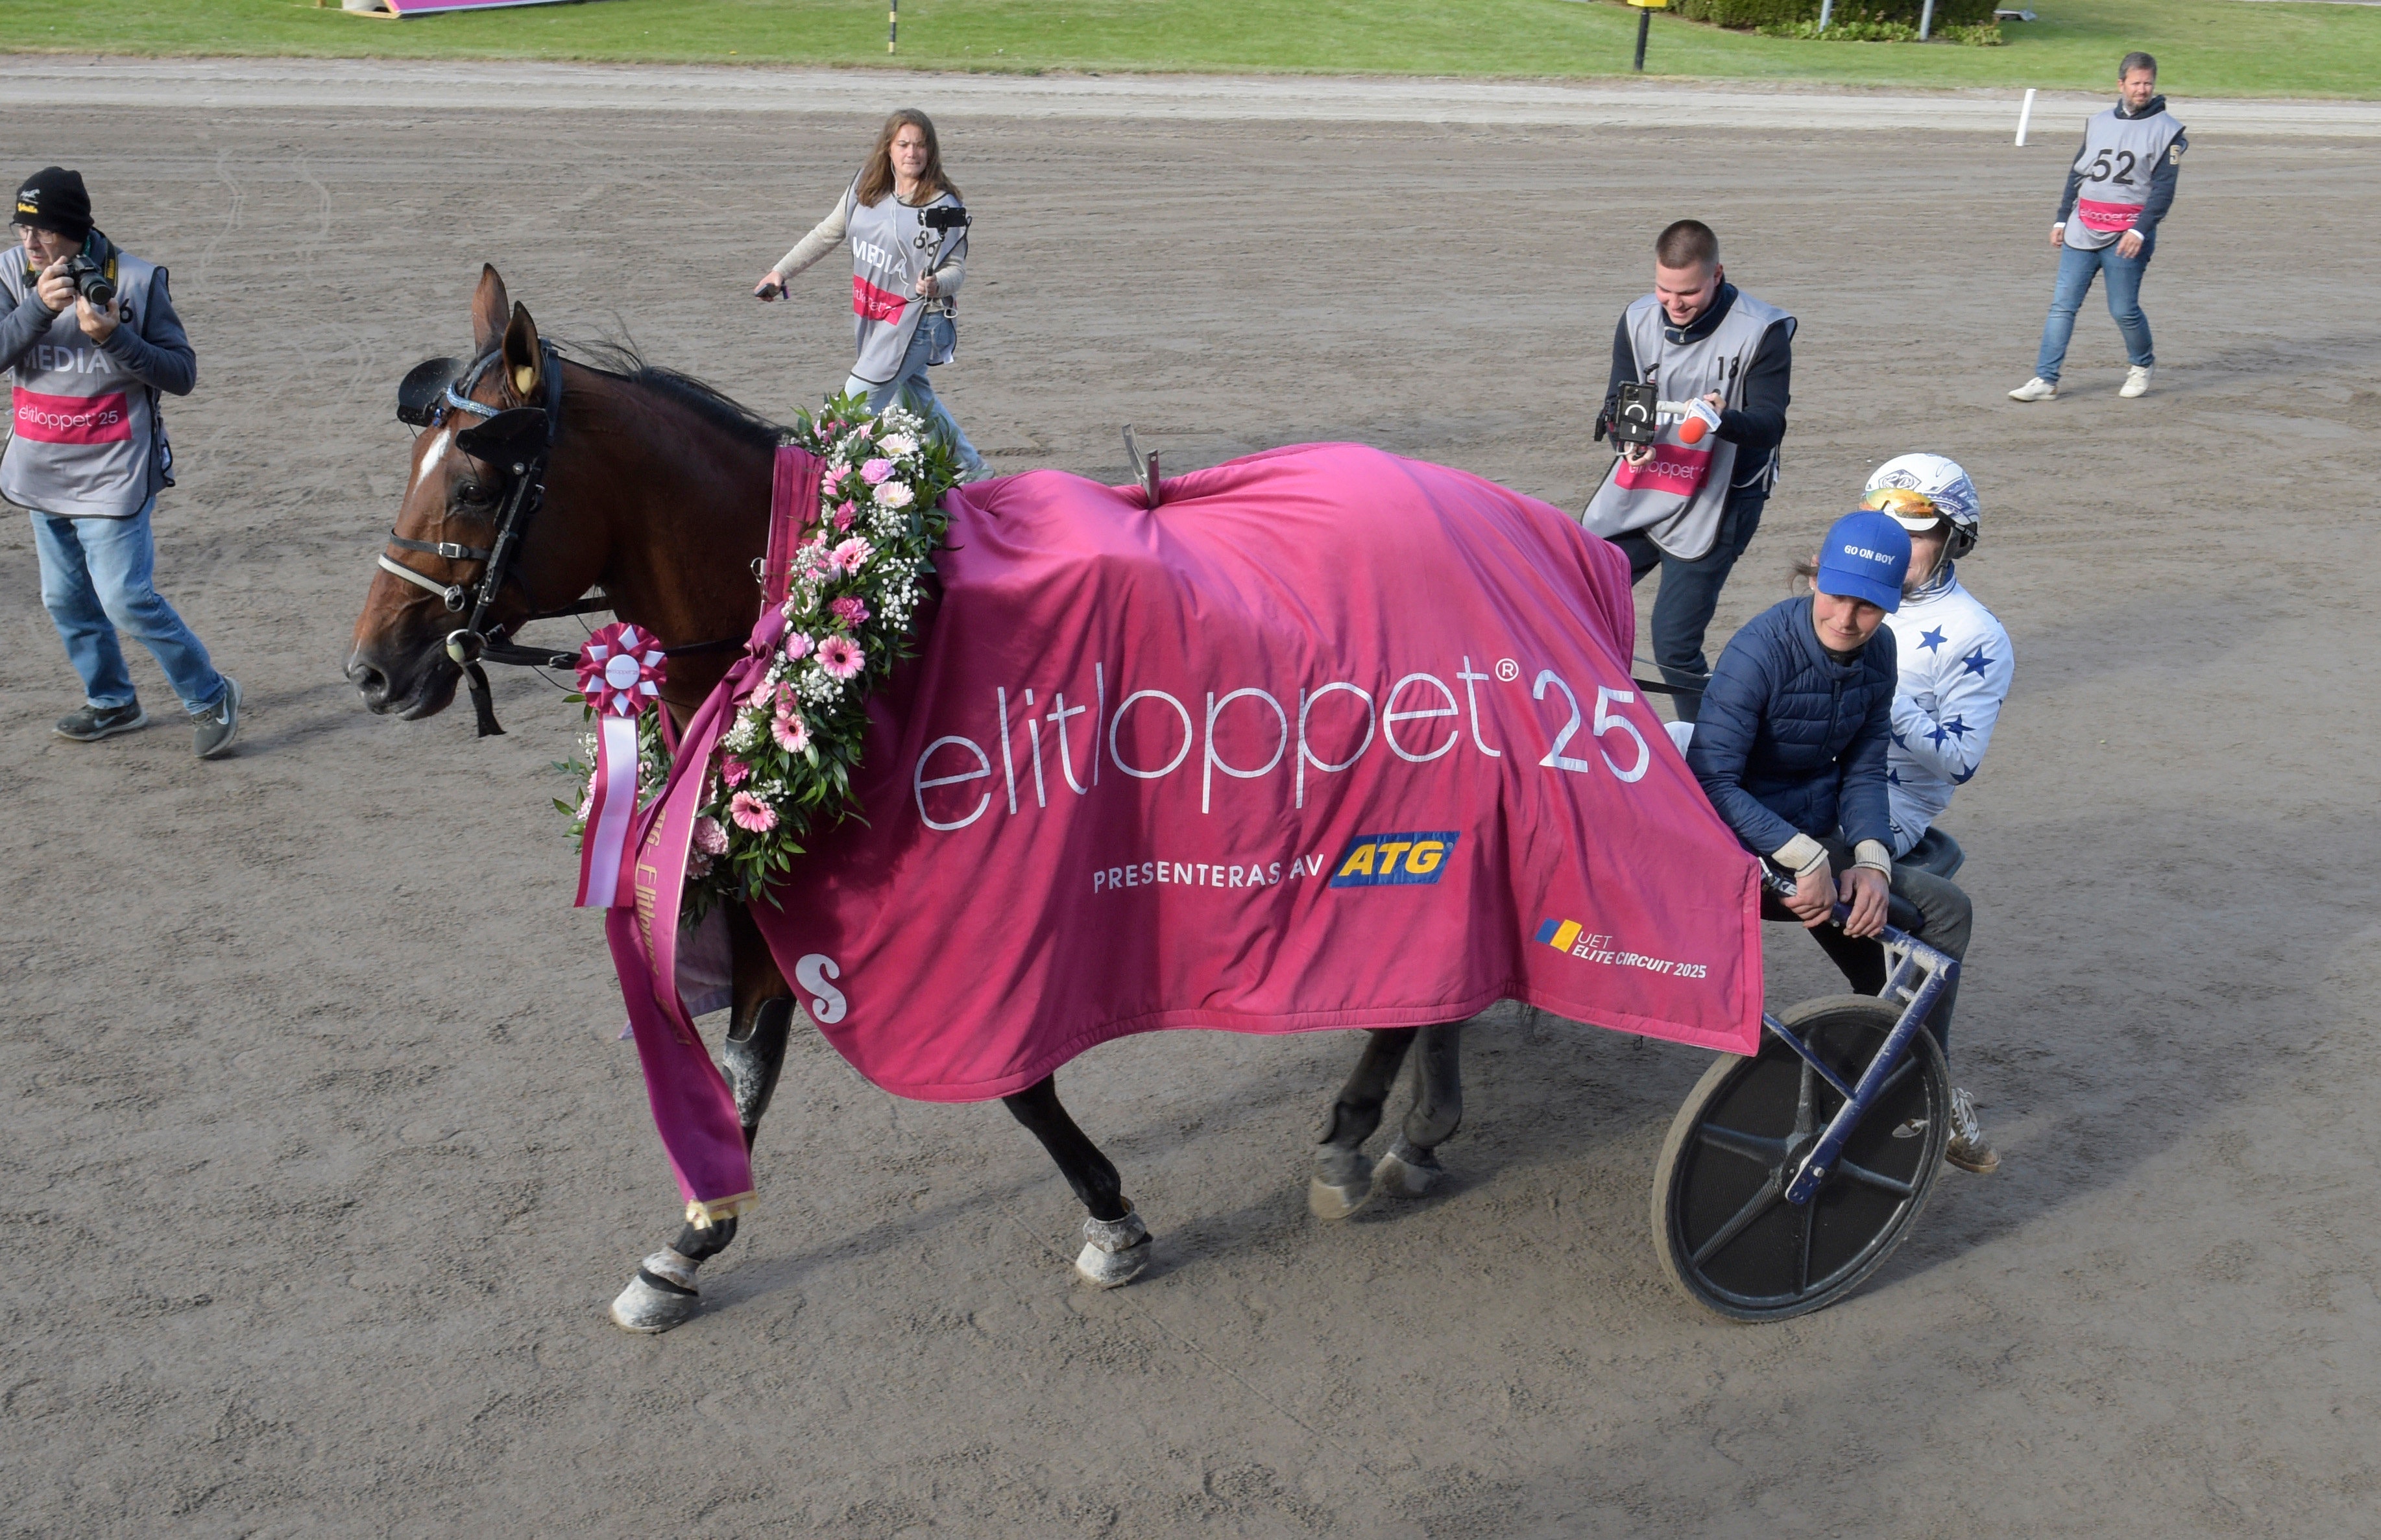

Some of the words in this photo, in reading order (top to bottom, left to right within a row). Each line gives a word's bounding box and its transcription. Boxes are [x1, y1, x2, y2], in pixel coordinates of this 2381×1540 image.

[2092, 149, 2136, 185] 52
[853, 237, 907, 279] MEDIA
[1718, 356, 1739, 380] 18
[99, 410, 119, 425] 25
[1844, 545, 1858, 555] GO
[1859, 548, 1874, 560] ON
[1875, 553, 1895, 565] BOY
[1533, 669, 1650, 782] 25
[1094, 861, 1281, 894] PRESENTERAS
[1289, 854, 1324, 880] AV
[1338, 841, 1444, 876] ATG
[1578, 931, 1612, 949] UET
[1572, 944, 1615, 965] ELITE
[1615, 952, 1674, 974] CIRCUIT
[1673, 963, 1707, 979] 2025
